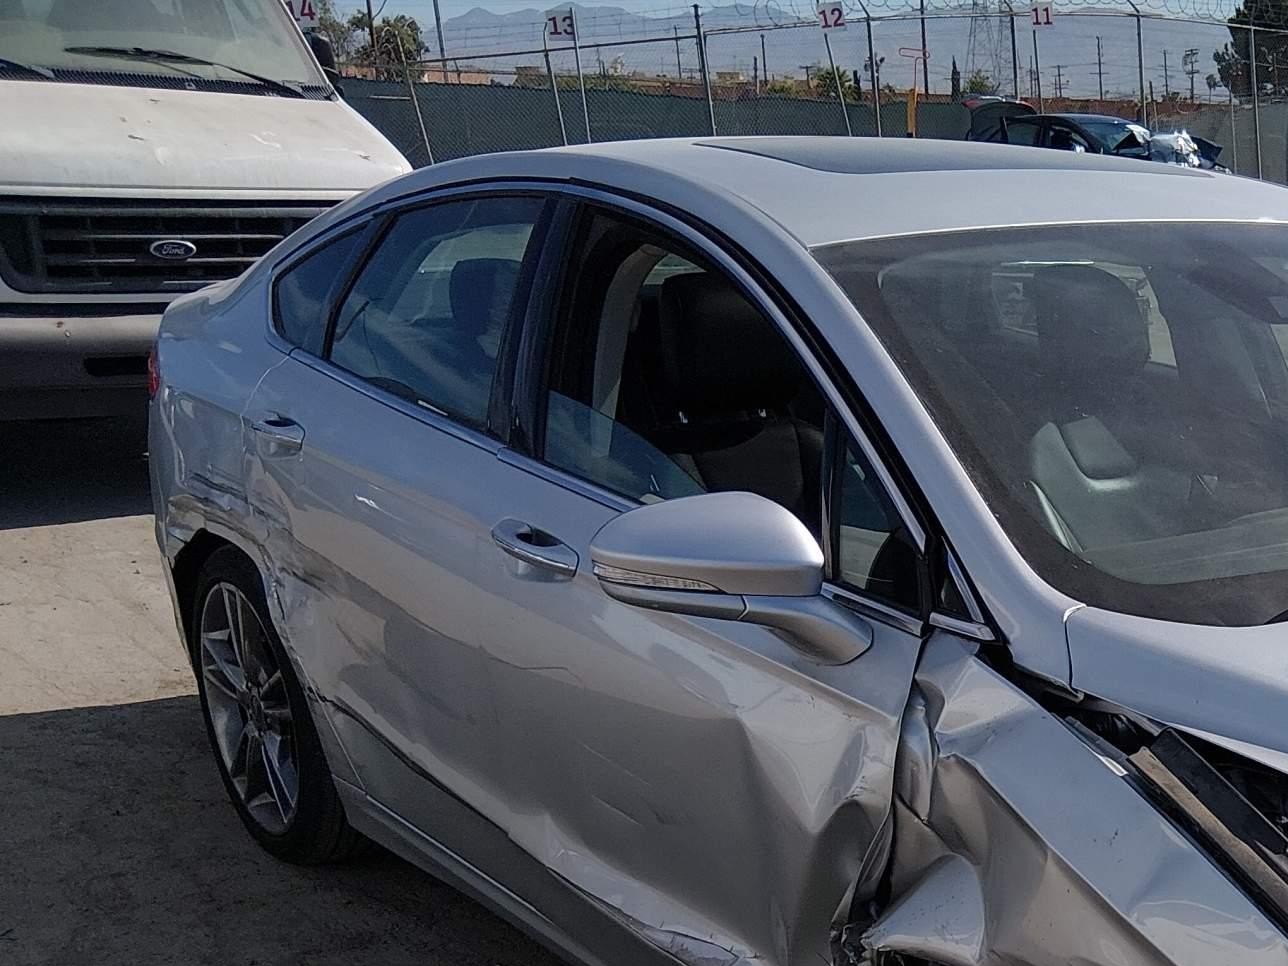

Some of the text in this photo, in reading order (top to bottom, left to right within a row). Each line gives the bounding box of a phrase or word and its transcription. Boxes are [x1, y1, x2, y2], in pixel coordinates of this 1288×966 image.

[547, 15, 574, 36] 13
[819, 7, 845, 29] 12
[1031, 6, 1053, 26] 11
[161, 244, 186, 255] Ford
